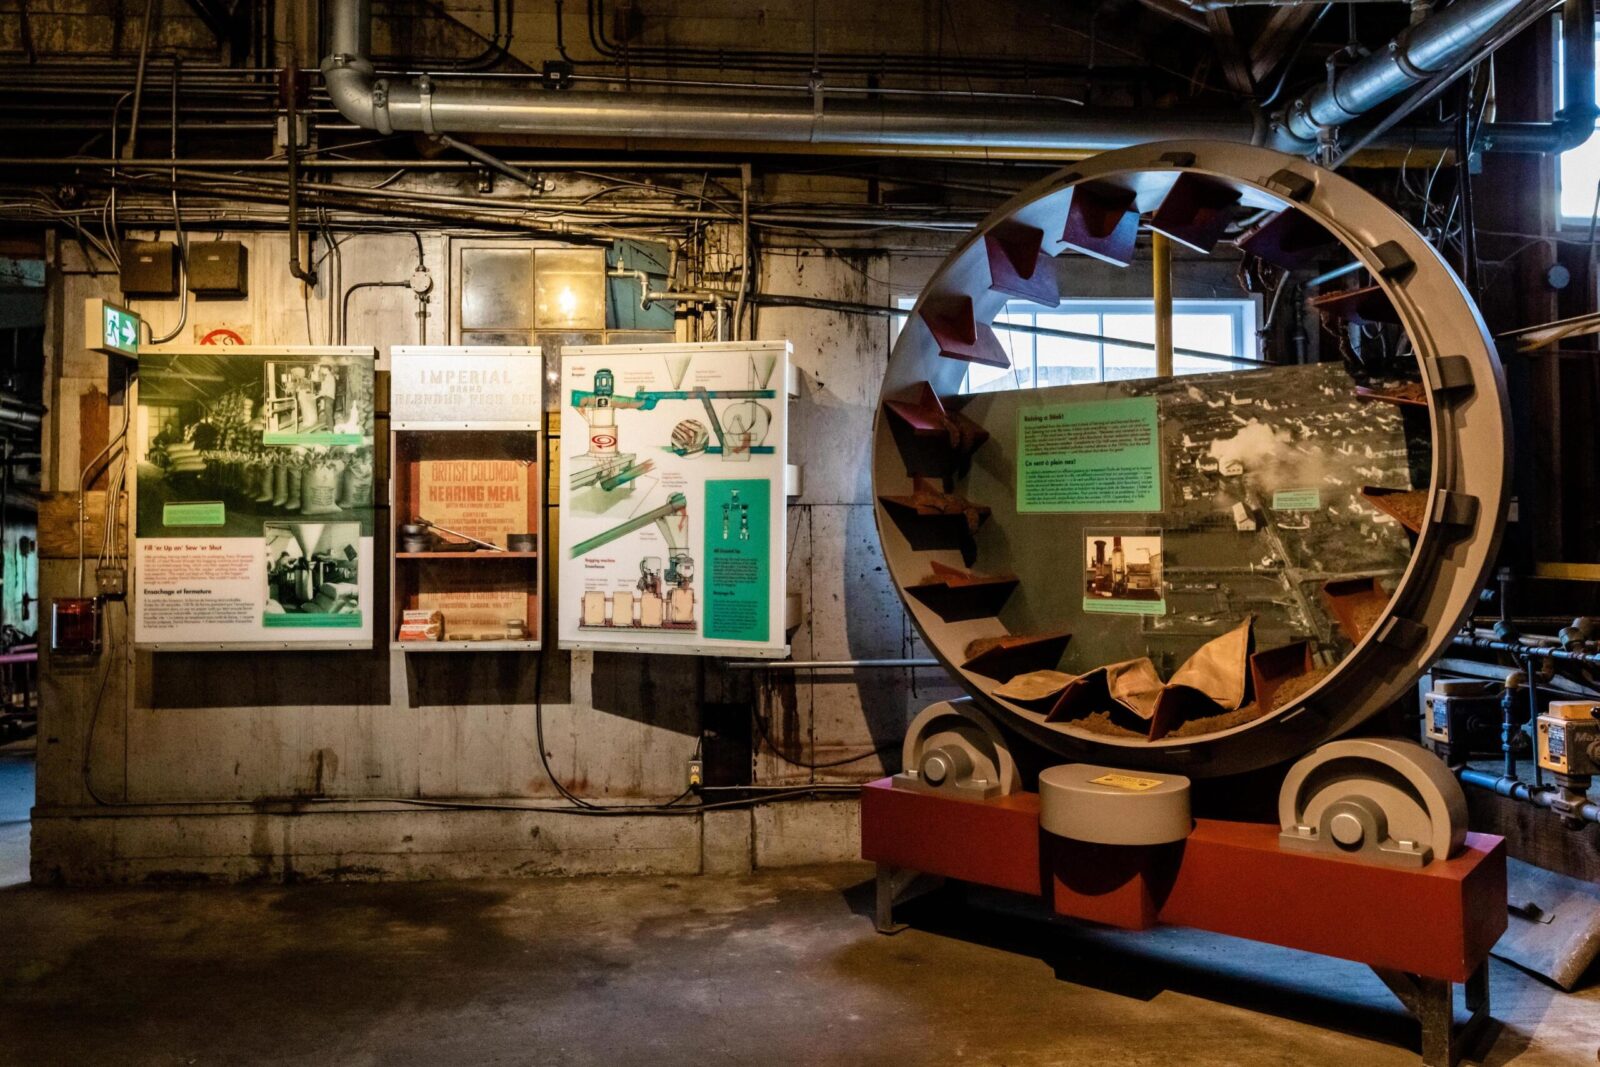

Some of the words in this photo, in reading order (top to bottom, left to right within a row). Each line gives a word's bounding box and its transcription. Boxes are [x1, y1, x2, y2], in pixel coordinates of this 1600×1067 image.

[420, 370, 512, 384] IMPERIAL
[450, 385, 482, 393] BRAND
[432, 462, 468, 481] BRITISH
[471, 462, 519, 481] COLUMBIA
[429, 486, 485, 501] HERRING
[487, 486, 521, 501] MEAL
[143, 588, 175, 596] Ensachage
